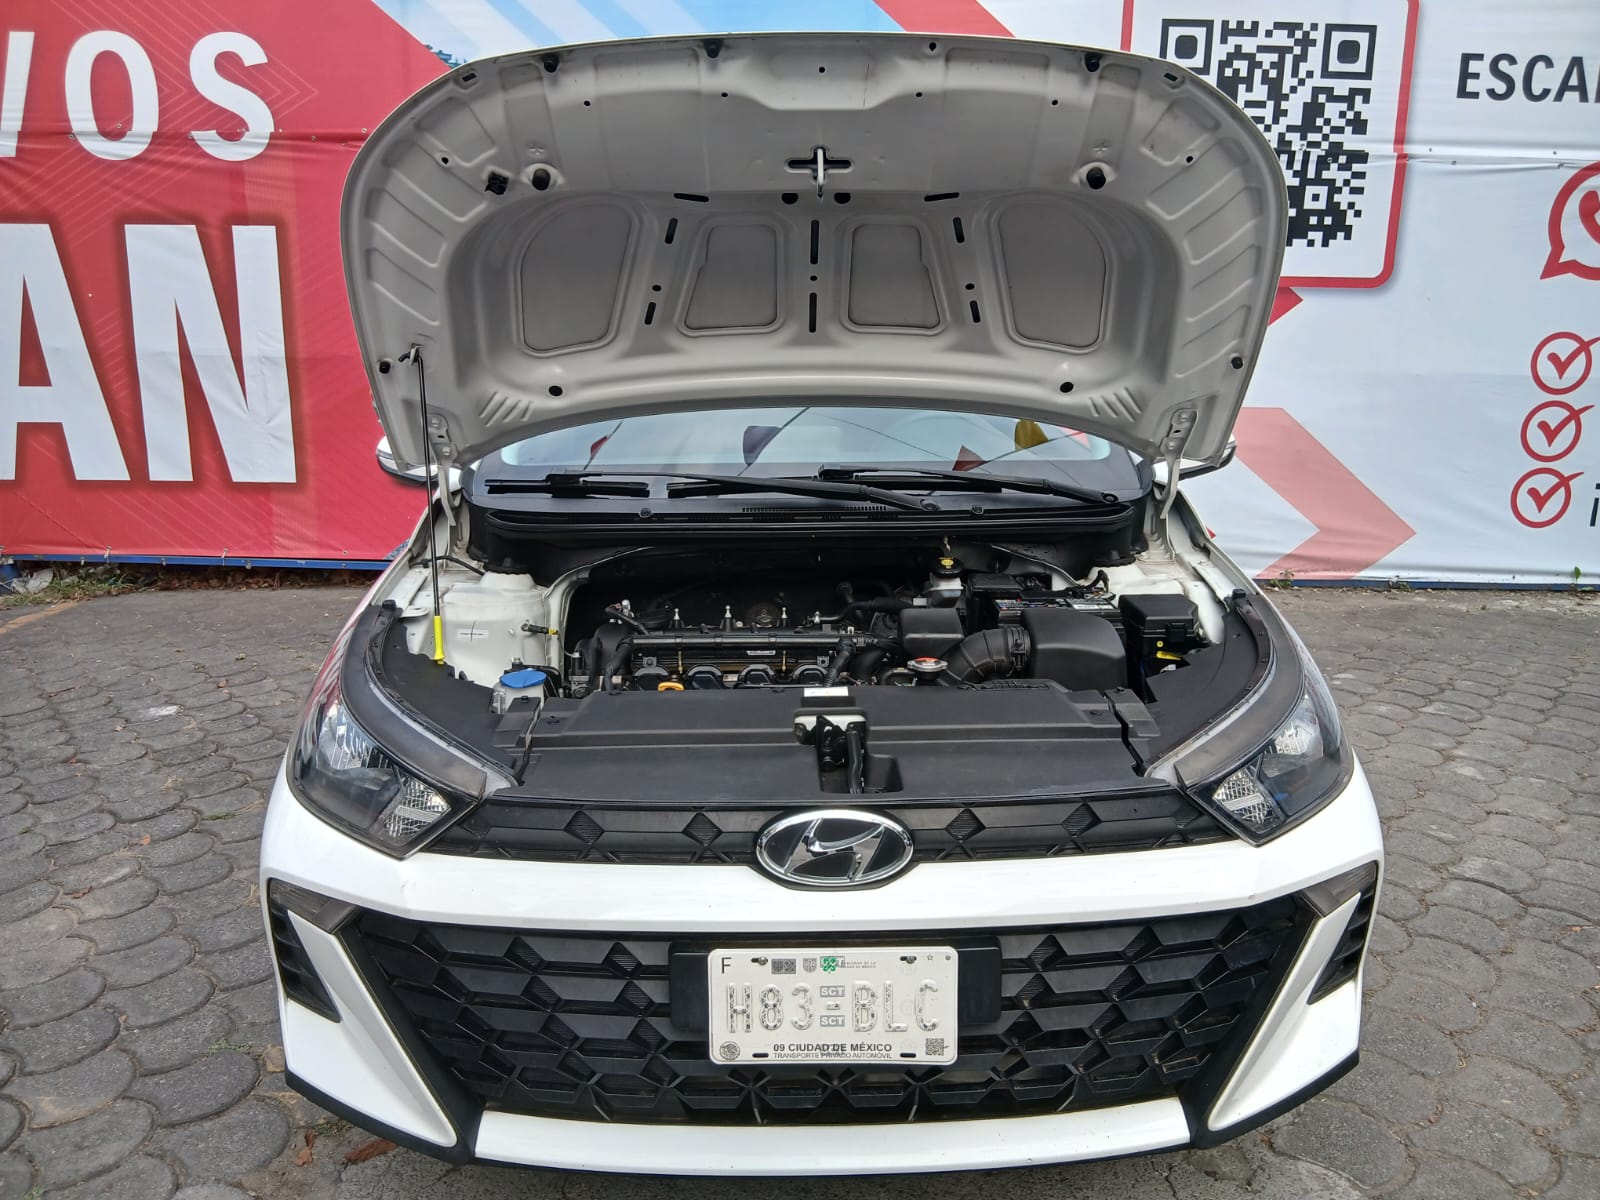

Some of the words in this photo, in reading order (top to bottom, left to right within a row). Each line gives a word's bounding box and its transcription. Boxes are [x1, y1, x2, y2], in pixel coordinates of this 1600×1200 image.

[1456, 52, 1600, 103] ESCA
[721, 957, 732, 974] F
[820, 986, 845, 997] SCT
[726, 979, 939, 1033] H83-BLC
[820, 1015, 845, 1027] SCT
[773, 1043, 786, 1052] 09
[788, 1043, 830, 1052] CIUDAD
[832, 1043, 847, 1052] DE
[850, 1041, 893, 1052] MÉXICO
